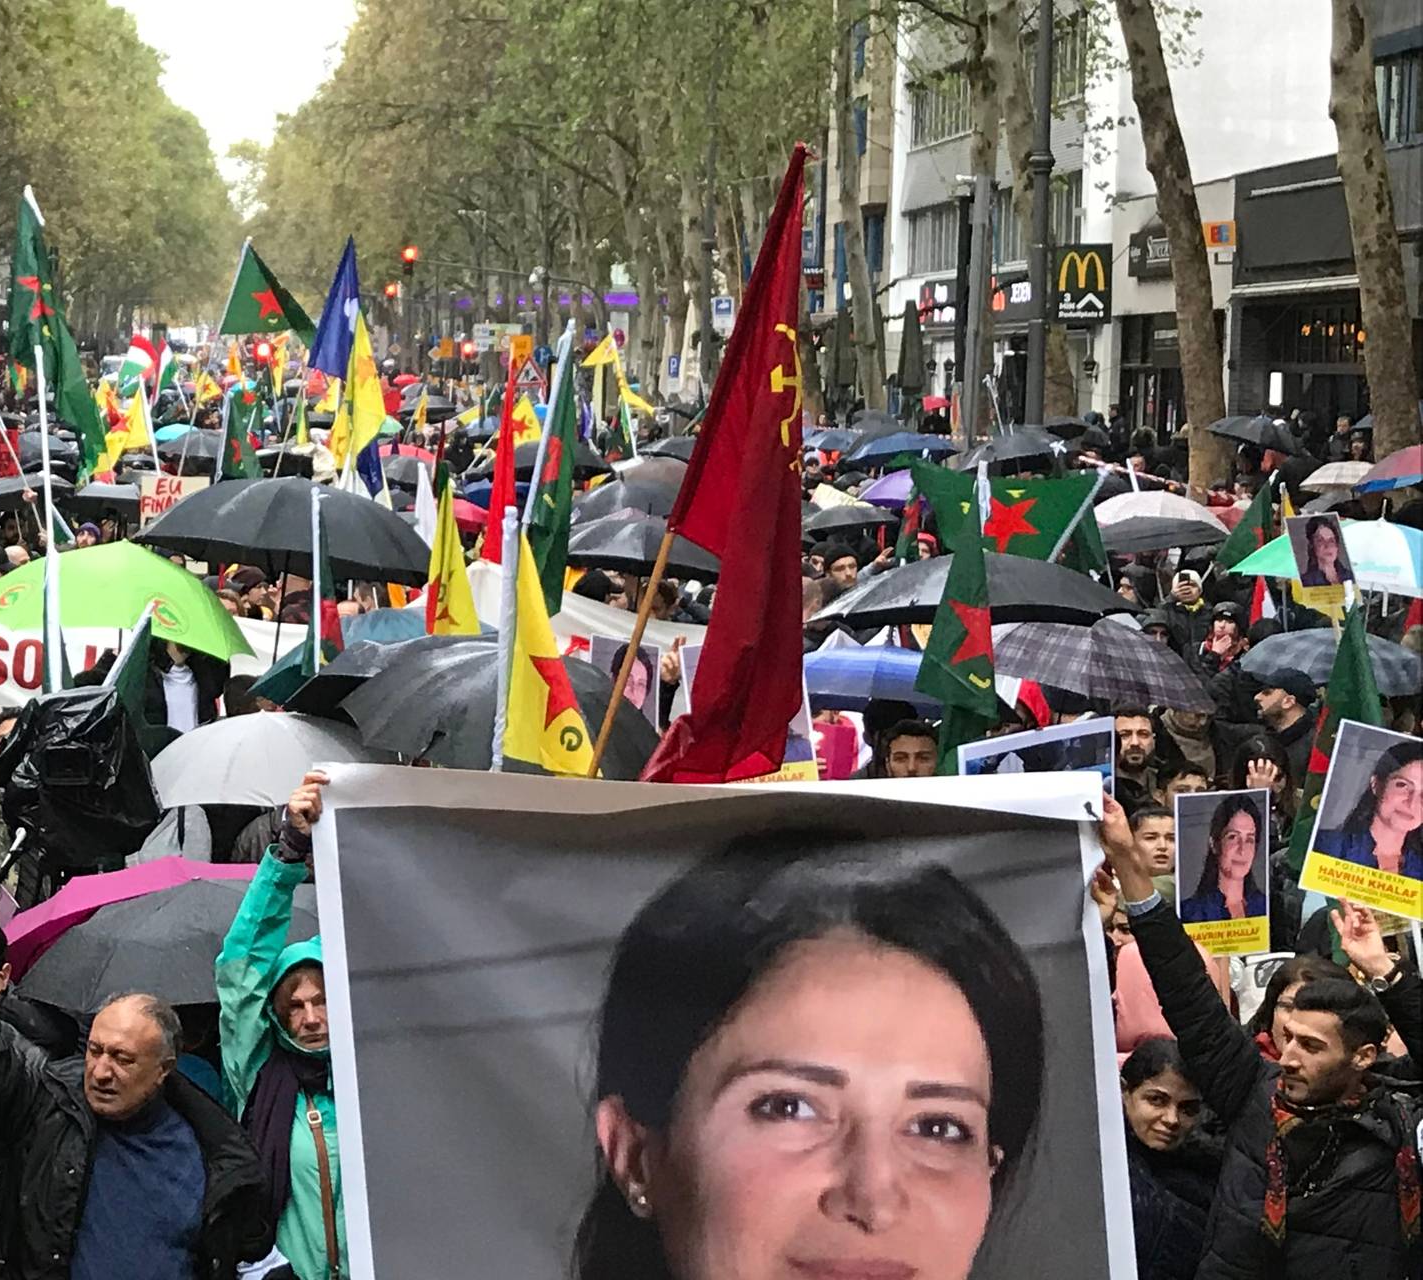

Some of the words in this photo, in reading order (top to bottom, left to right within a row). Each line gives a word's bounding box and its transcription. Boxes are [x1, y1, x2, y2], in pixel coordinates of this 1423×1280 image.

[156, 477, 182, 495] EU
[142, 495, 178, 513] FINA
[1318, 865, 1365, 885] HAVRIN
[1368, 879, 1419, 898] KHALAF
[1227, 927, 1261, 937] KHALAF
